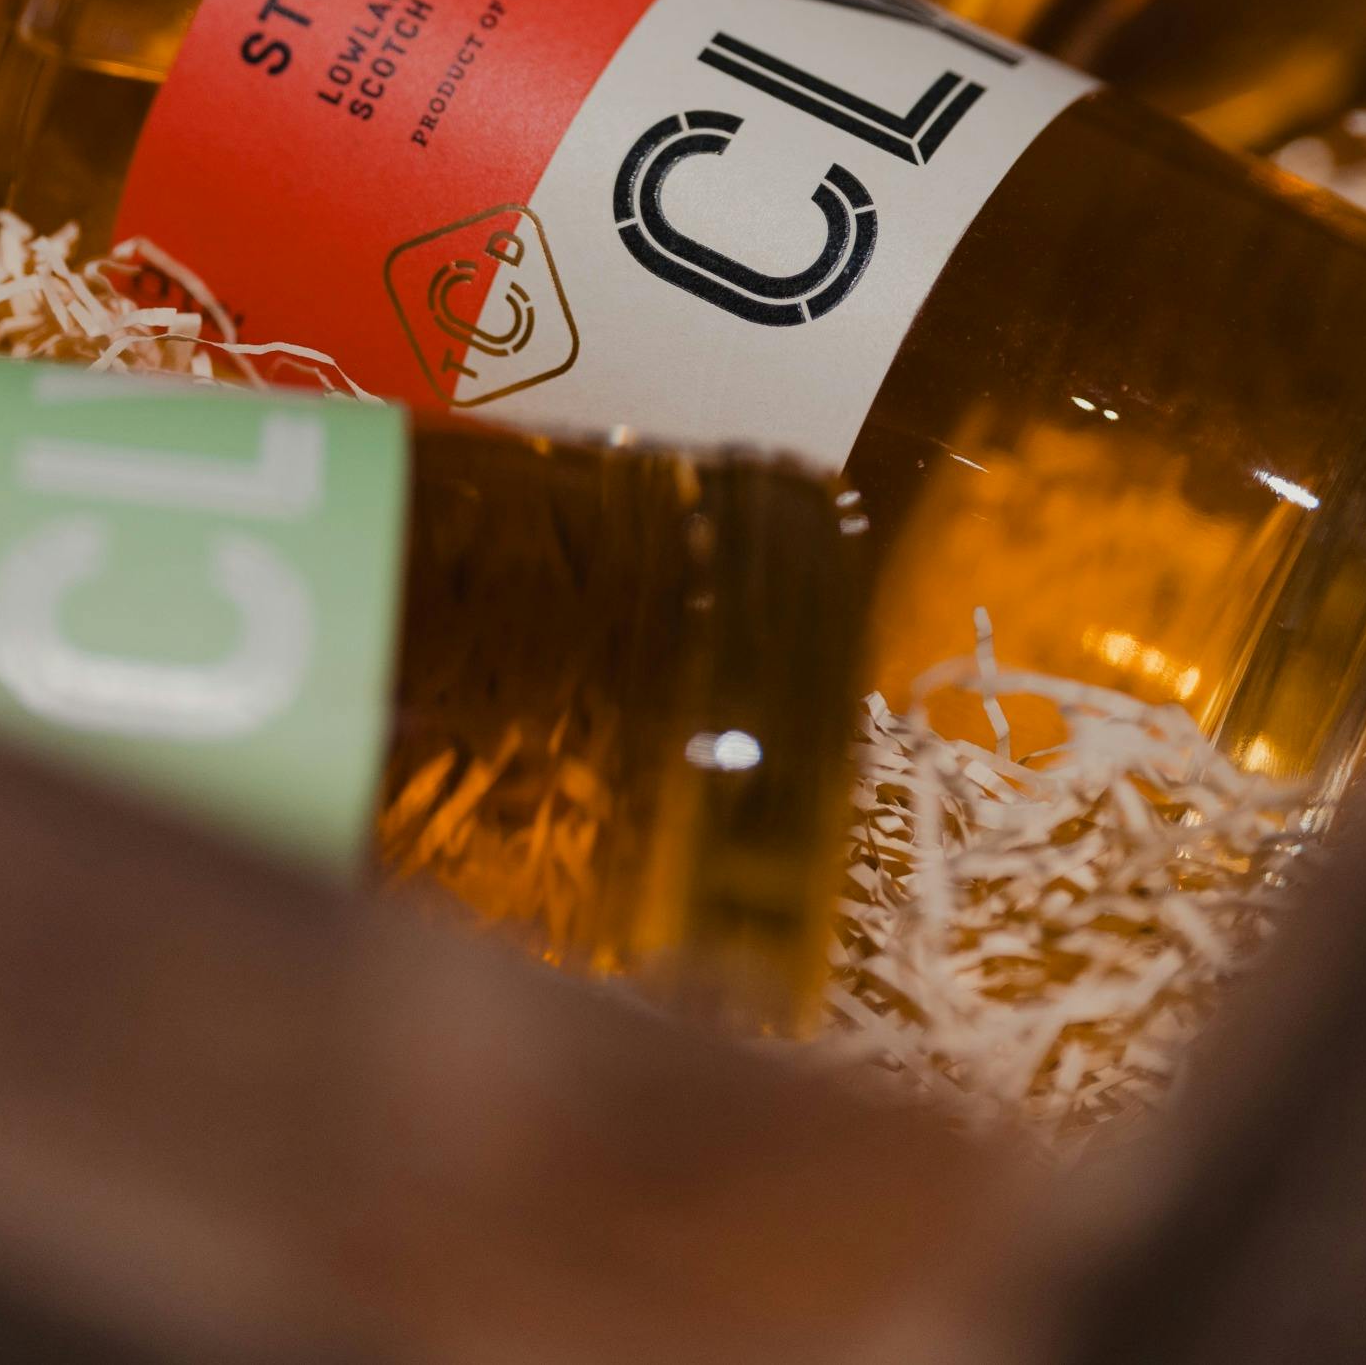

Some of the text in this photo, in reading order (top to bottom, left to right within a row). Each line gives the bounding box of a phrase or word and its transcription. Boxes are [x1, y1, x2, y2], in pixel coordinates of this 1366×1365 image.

[350, 1, 435, 121] SCOTCH
[411, 34, 482, 147] PRODUCT
[480, 0, 507, 30] OF
